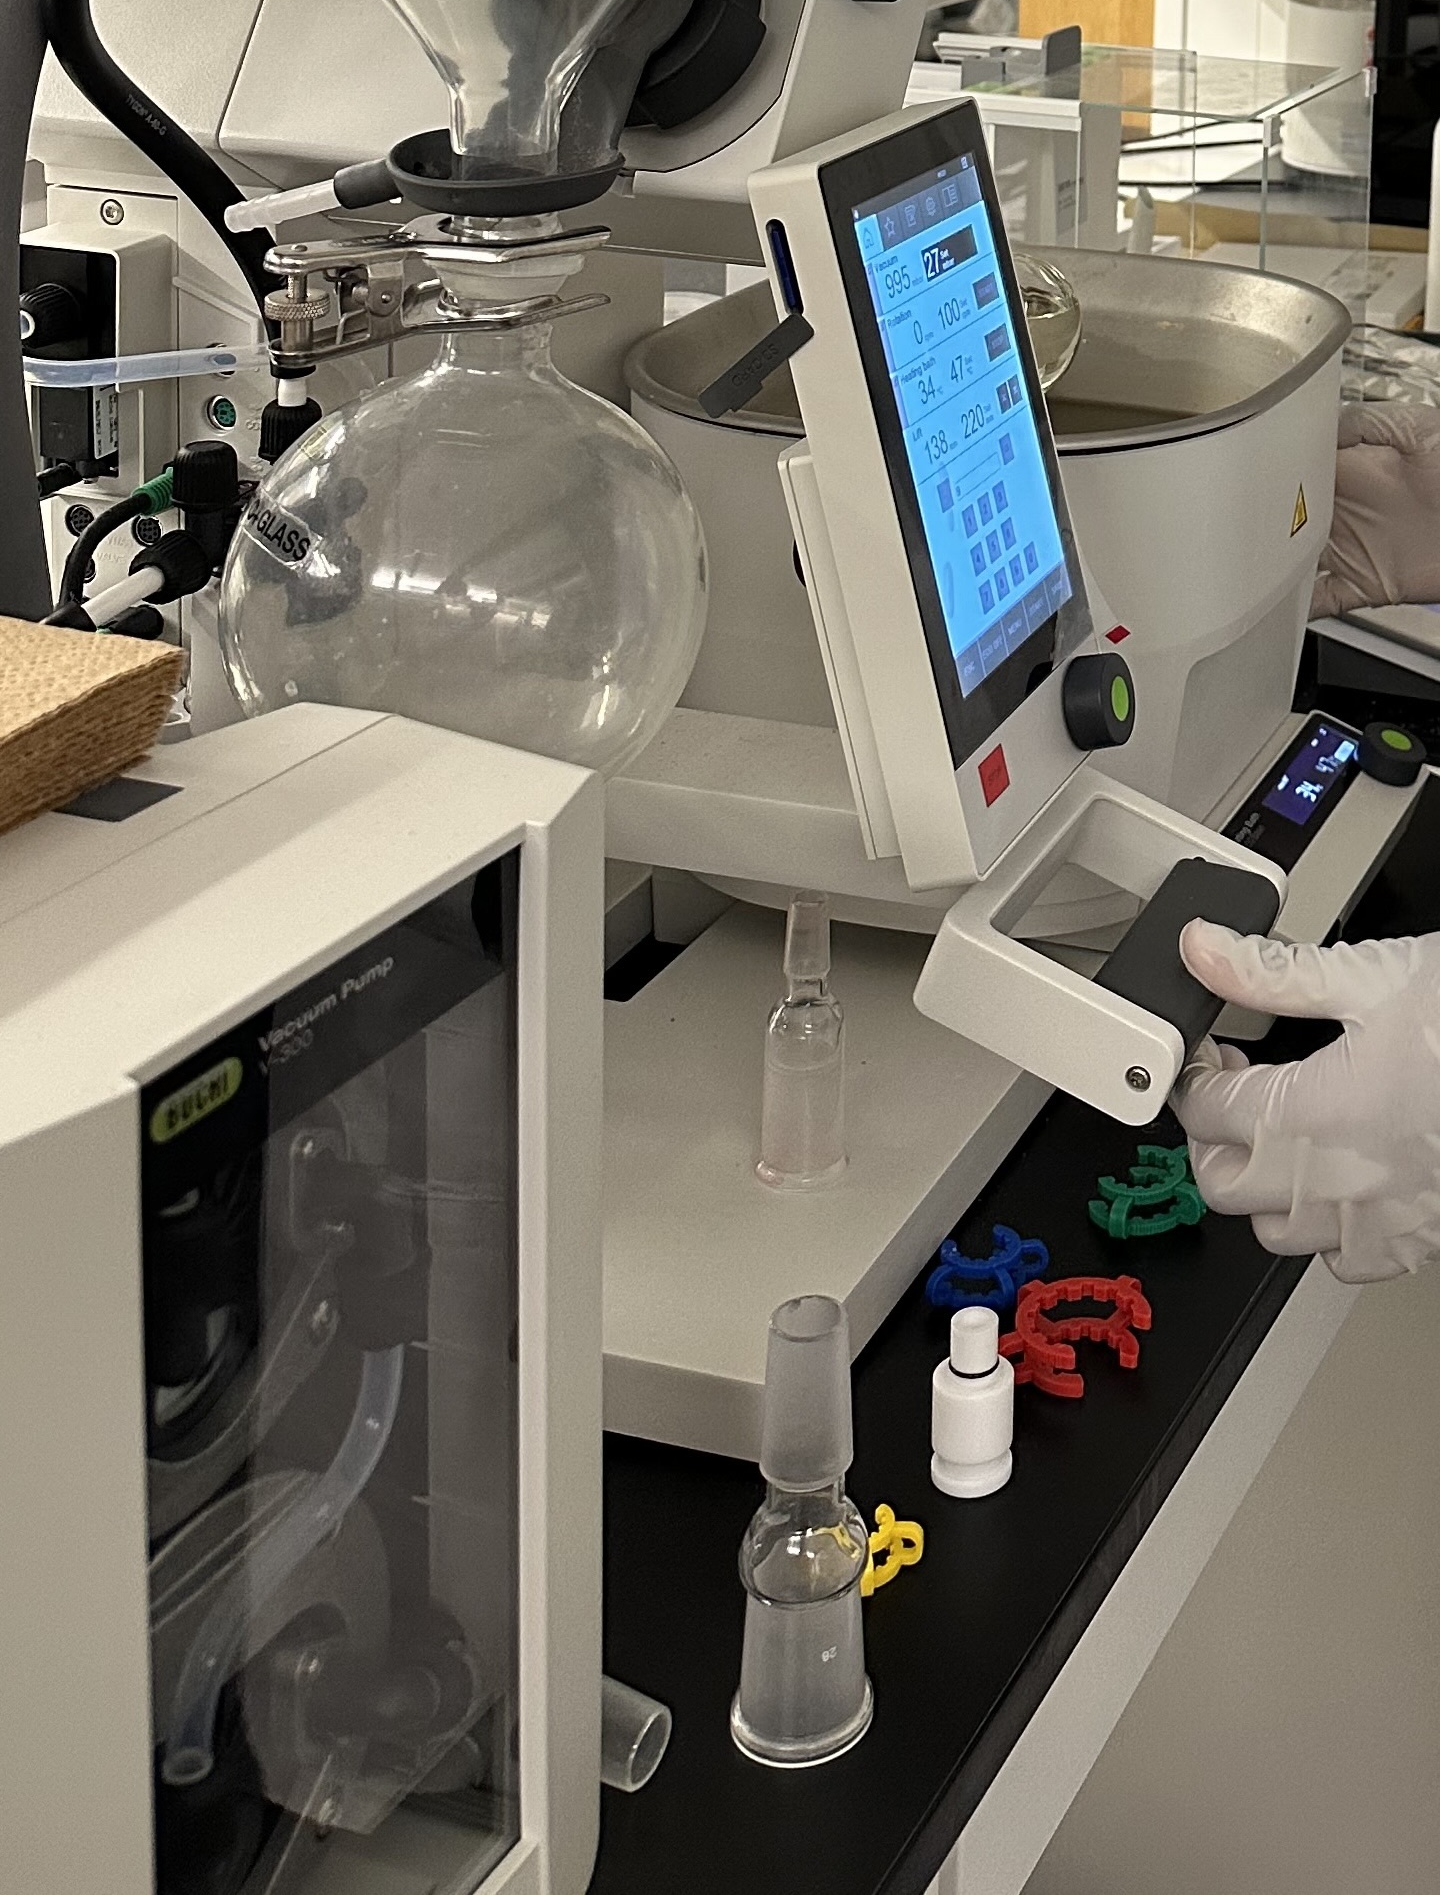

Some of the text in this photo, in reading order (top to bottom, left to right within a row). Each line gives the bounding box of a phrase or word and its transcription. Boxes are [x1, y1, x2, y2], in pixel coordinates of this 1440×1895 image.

[874, 256, 898, 273] Vacuum
[885, 265, 911, 299] 995
[924, 248, 941, 278] 27
[887, 309, 912, 327] Rotation
[913, 320, 923, 344] 0
[938, 298, 960, 329] 100
[900, 364, 922, 383] Heating
[918, 375, 935, 404] 34
[951, 355, 964, 383] 47
[925, 430, 948, 464] 138
[961, 404, 985, 439] 220
[258, 956, 395, 1052] Vacuum Pump
